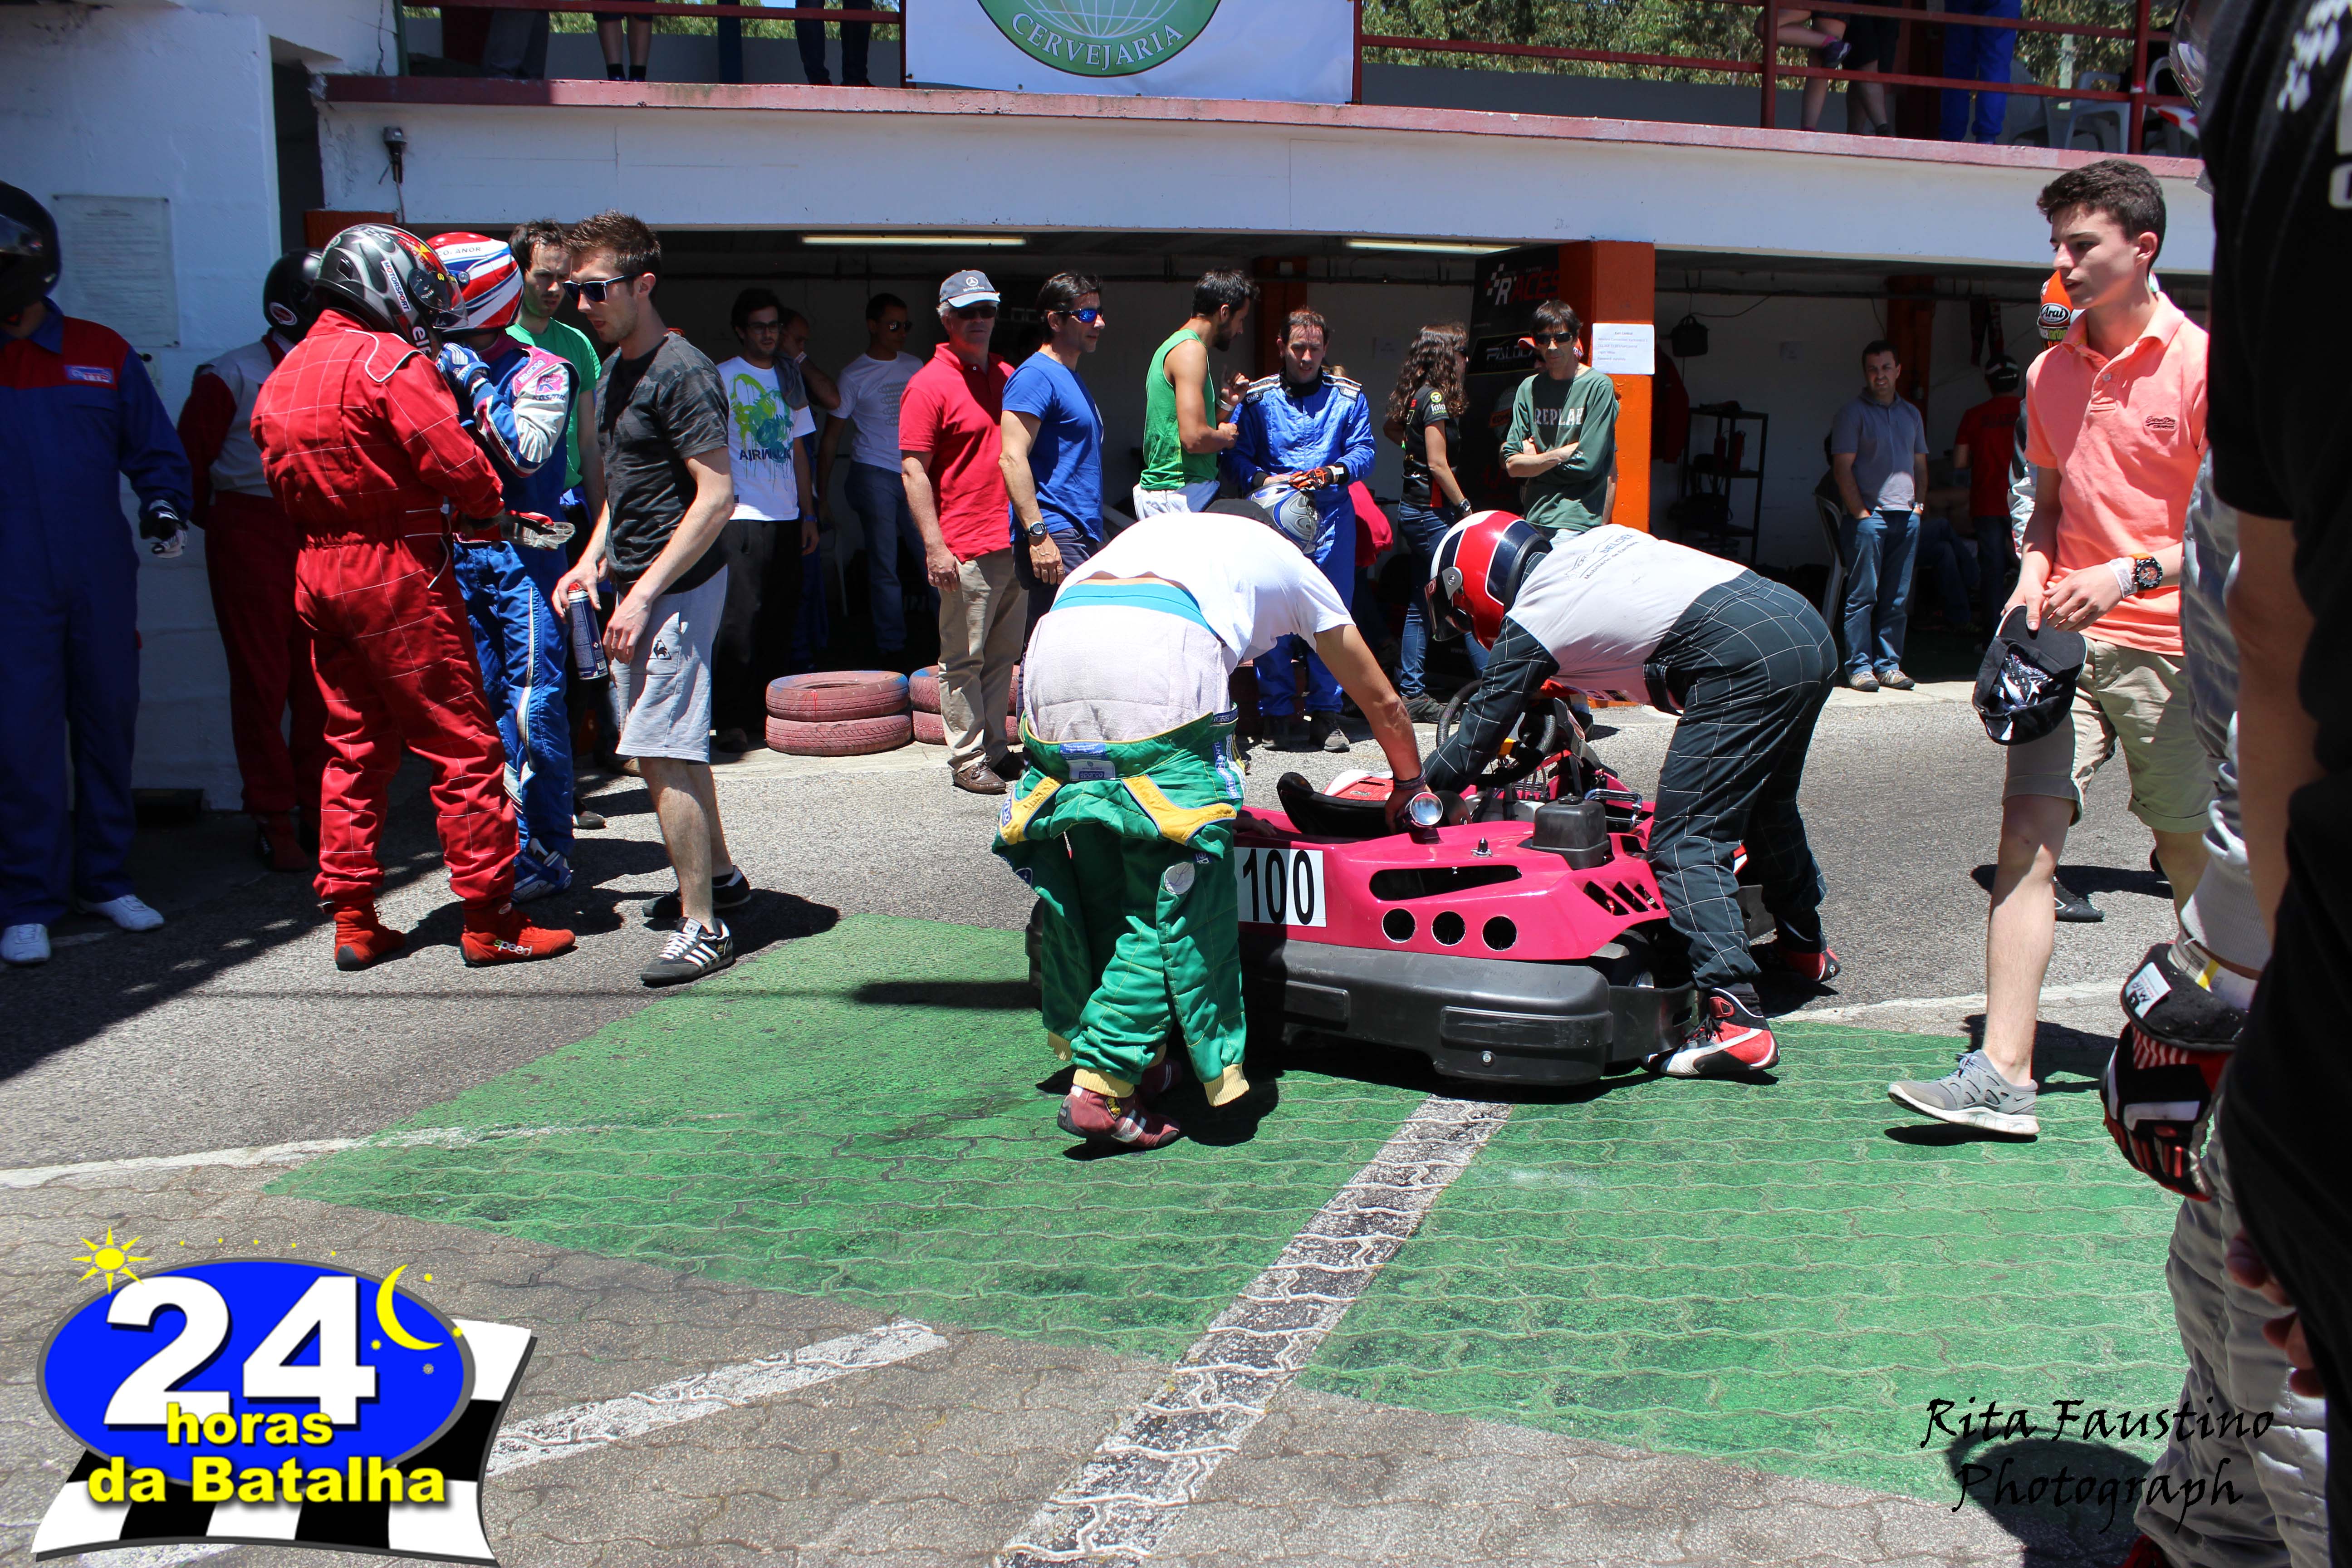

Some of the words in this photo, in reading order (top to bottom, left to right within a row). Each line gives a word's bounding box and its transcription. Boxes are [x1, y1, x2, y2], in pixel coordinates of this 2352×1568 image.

[1011, 12, 1184, 71] CERVEJARIA
[383, 262, 410, 310] MOTORSPORT
[2042, 306, 2063, 318] Arai
[517, 359, 546, 382] sparco
[1246, 393, 1259, 403] OMP
[1343, 389, 1358, 398] OMP
[1431, 403, 1446, 412] foto
[1242, 848, 1315, 925] 100
[493, 939, 533, 956] speed
